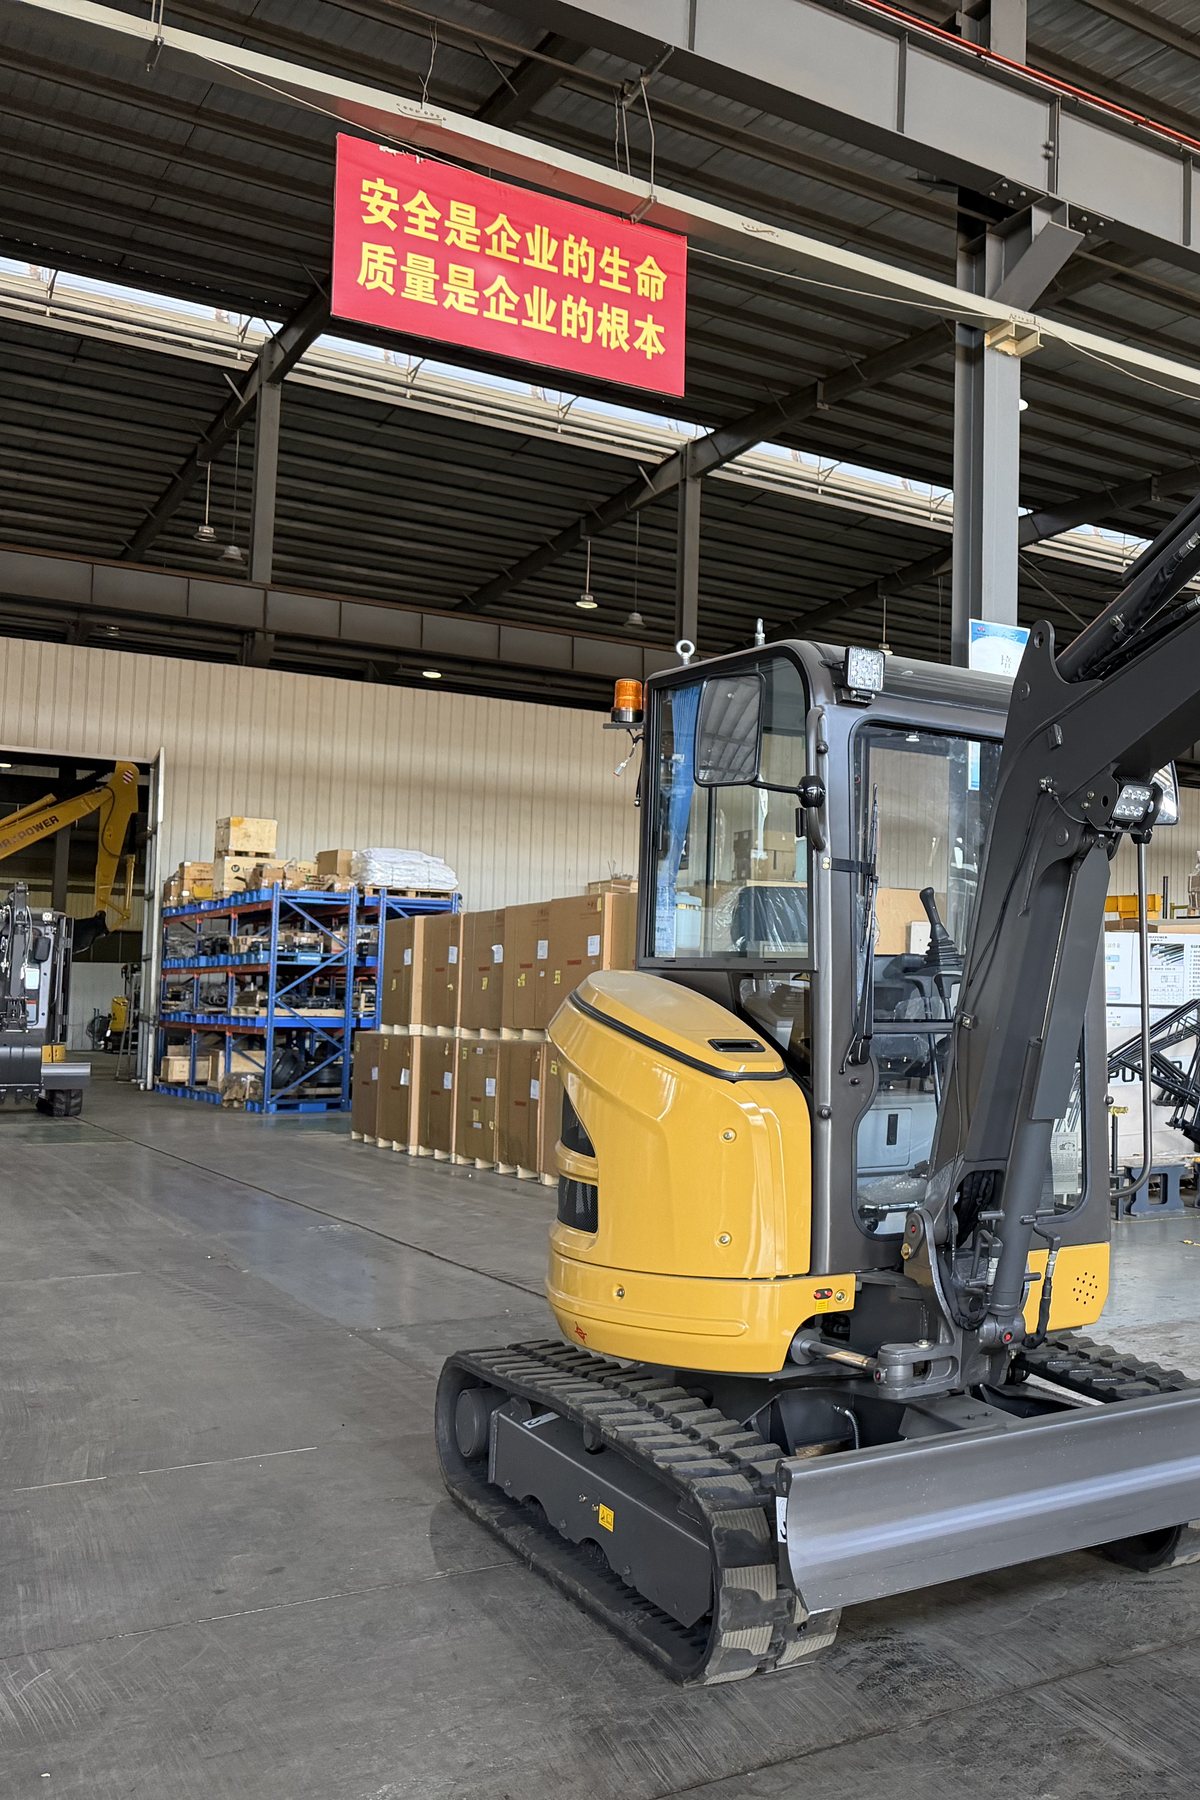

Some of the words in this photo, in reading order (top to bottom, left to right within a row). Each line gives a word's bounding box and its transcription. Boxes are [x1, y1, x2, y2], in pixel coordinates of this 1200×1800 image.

[356, 240, 666, 361] 质量是企业的根本
[360, 177, 668, 303] 安全是企业的生命
